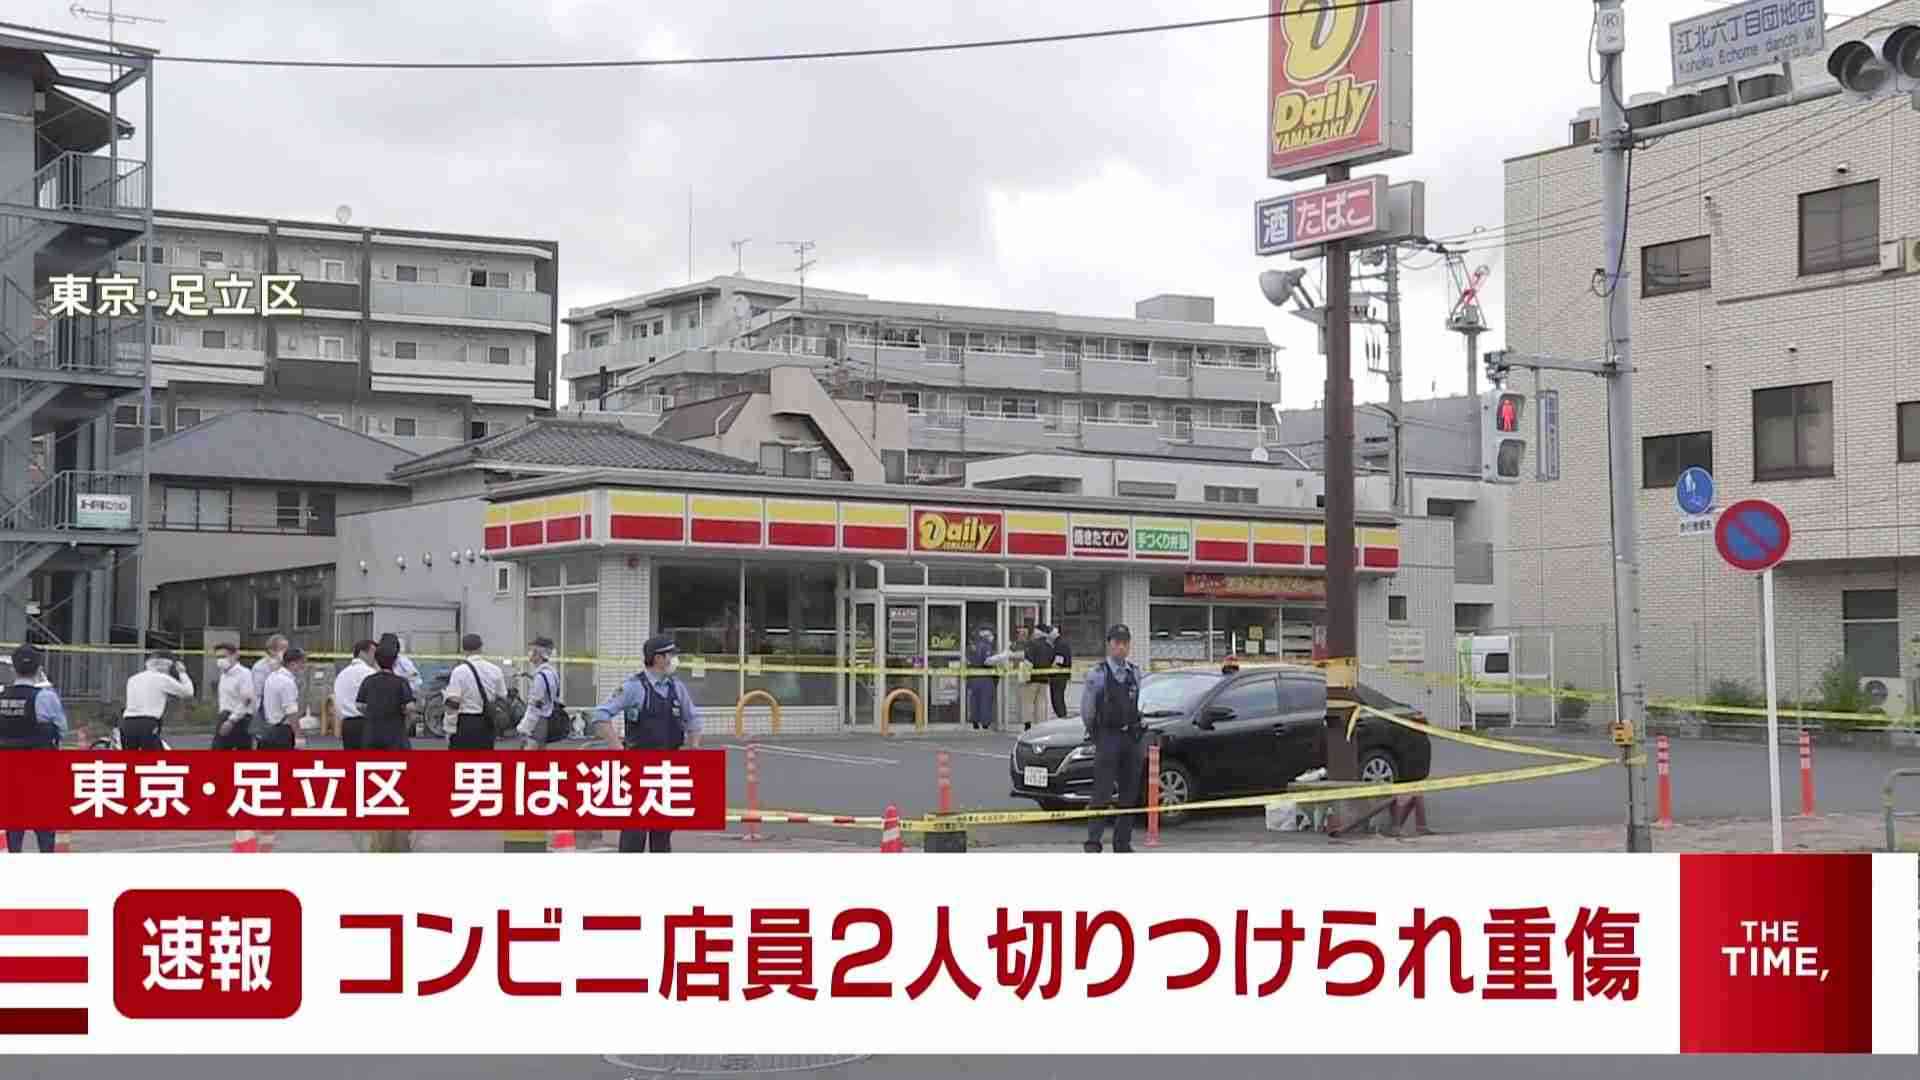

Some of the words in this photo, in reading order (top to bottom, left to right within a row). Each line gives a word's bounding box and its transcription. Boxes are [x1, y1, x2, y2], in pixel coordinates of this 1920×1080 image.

[1678, 0, 1817, 55] 江北六丁目団地西
[1275, 78, 1376, 135] Daily
[1275, 124, 1345, 151] YAMAZAKI
[1264, 205, 1290, 244] 酒
[1297, 189, 1371, 235] たばこ
[919, 513, 997, 551] Daily
